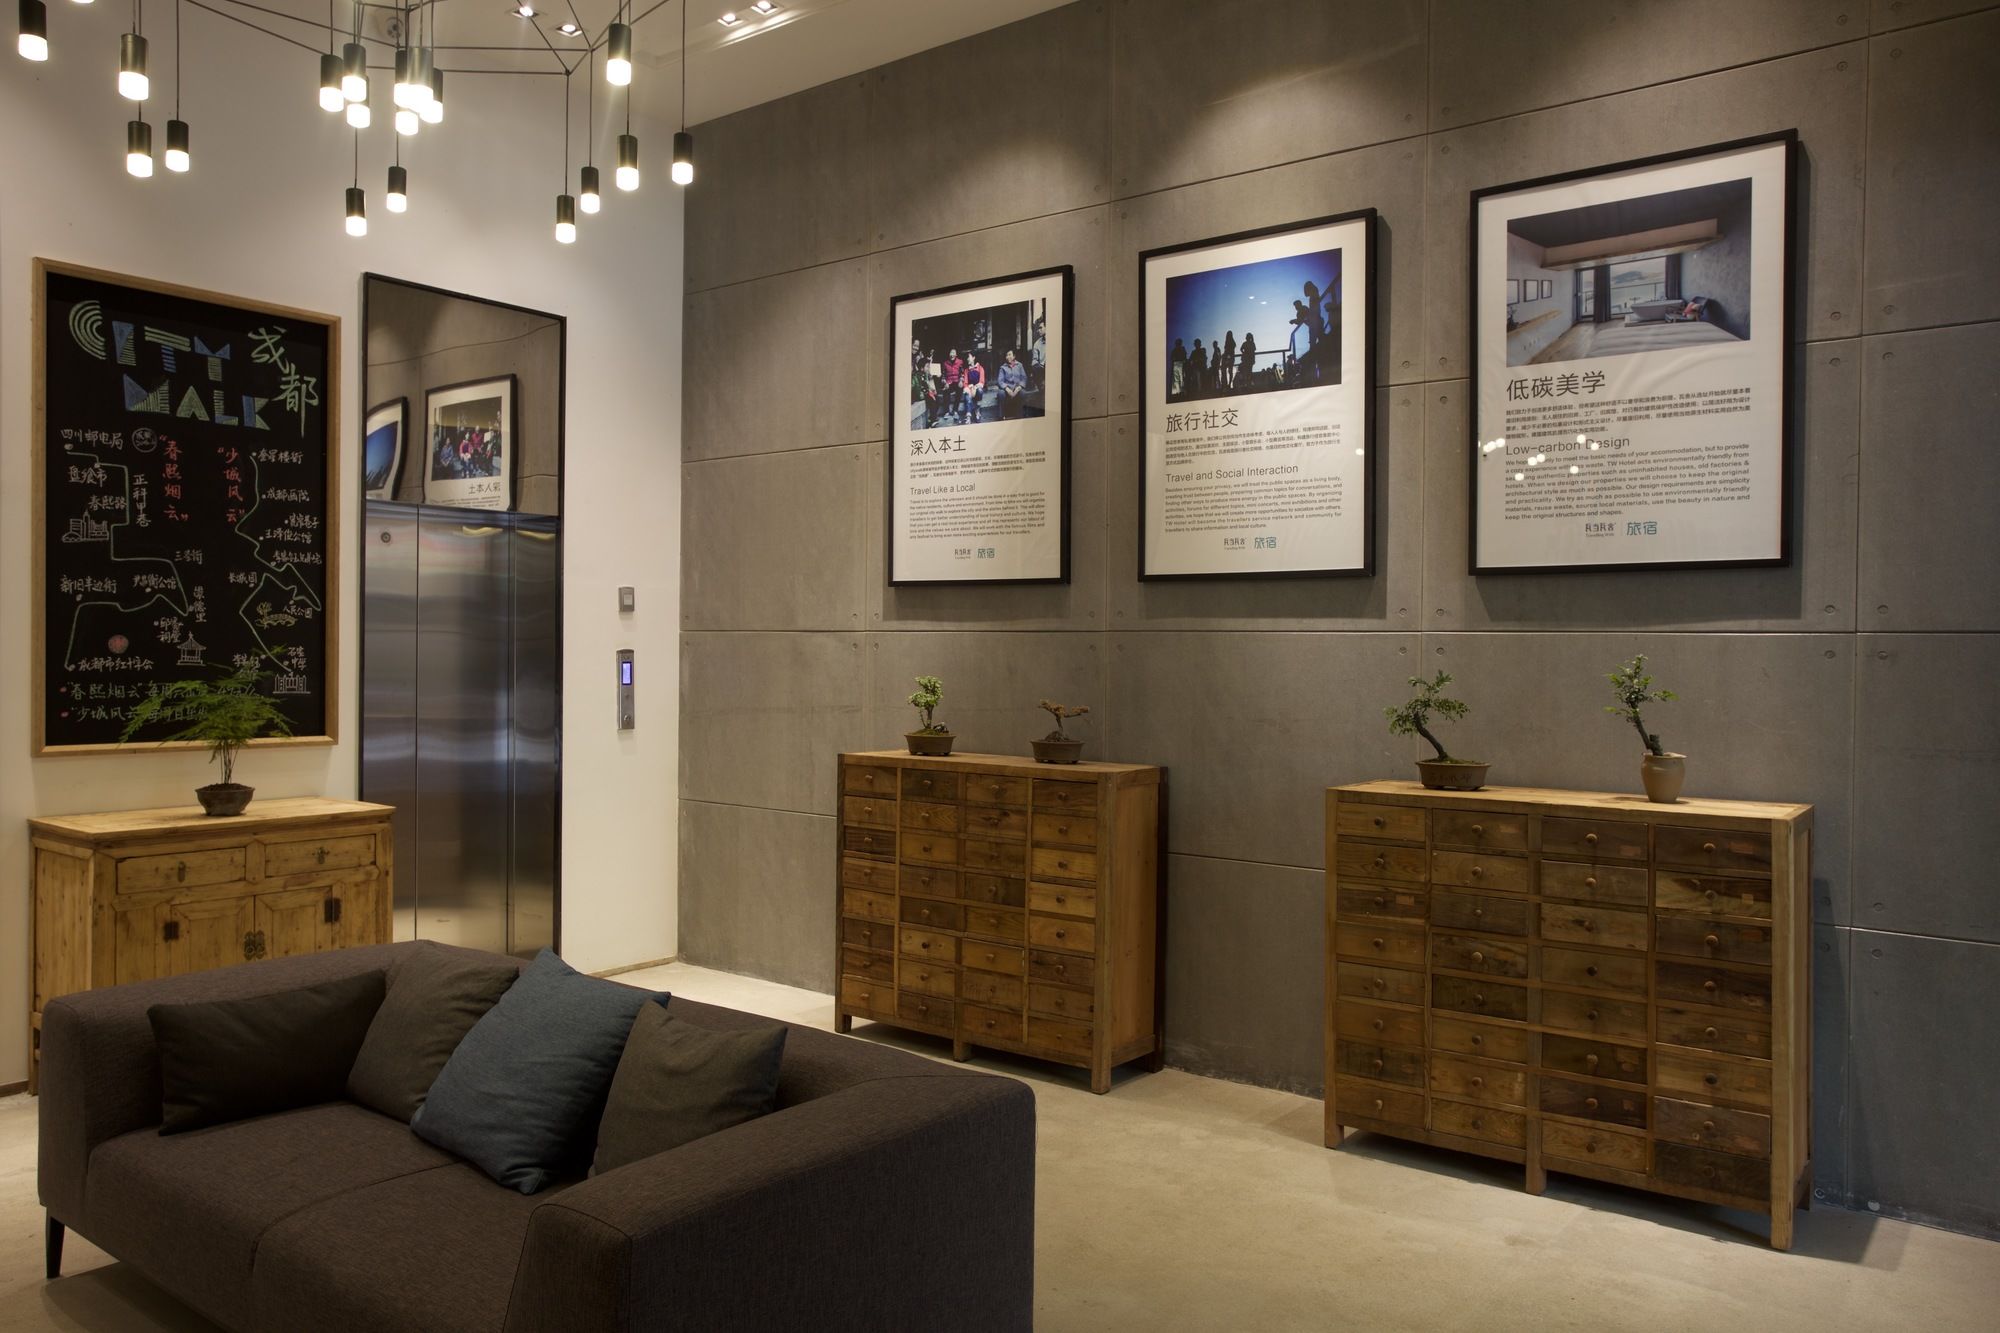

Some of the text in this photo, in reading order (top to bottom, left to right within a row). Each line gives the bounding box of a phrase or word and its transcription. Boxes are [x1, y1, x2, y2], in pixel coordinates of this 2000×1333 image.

[1506, 370, 1606, 401] 低碳美学
[123, 374, 271, 431] WALK
[1166, 408, 1239, 433] 旅行社交
[910, 435, 966, 457] 深入本土
[1166, 464, 1299, 483] Travel and Social Interaction
[910, 486, 932, 495] Travel
[933, 485, 948, 494] Like
[956, 483, 976, 492] Local
[1626, 521, 1658, 536] 旅宿
[1254, 536, 1277, 549] 旅宿
